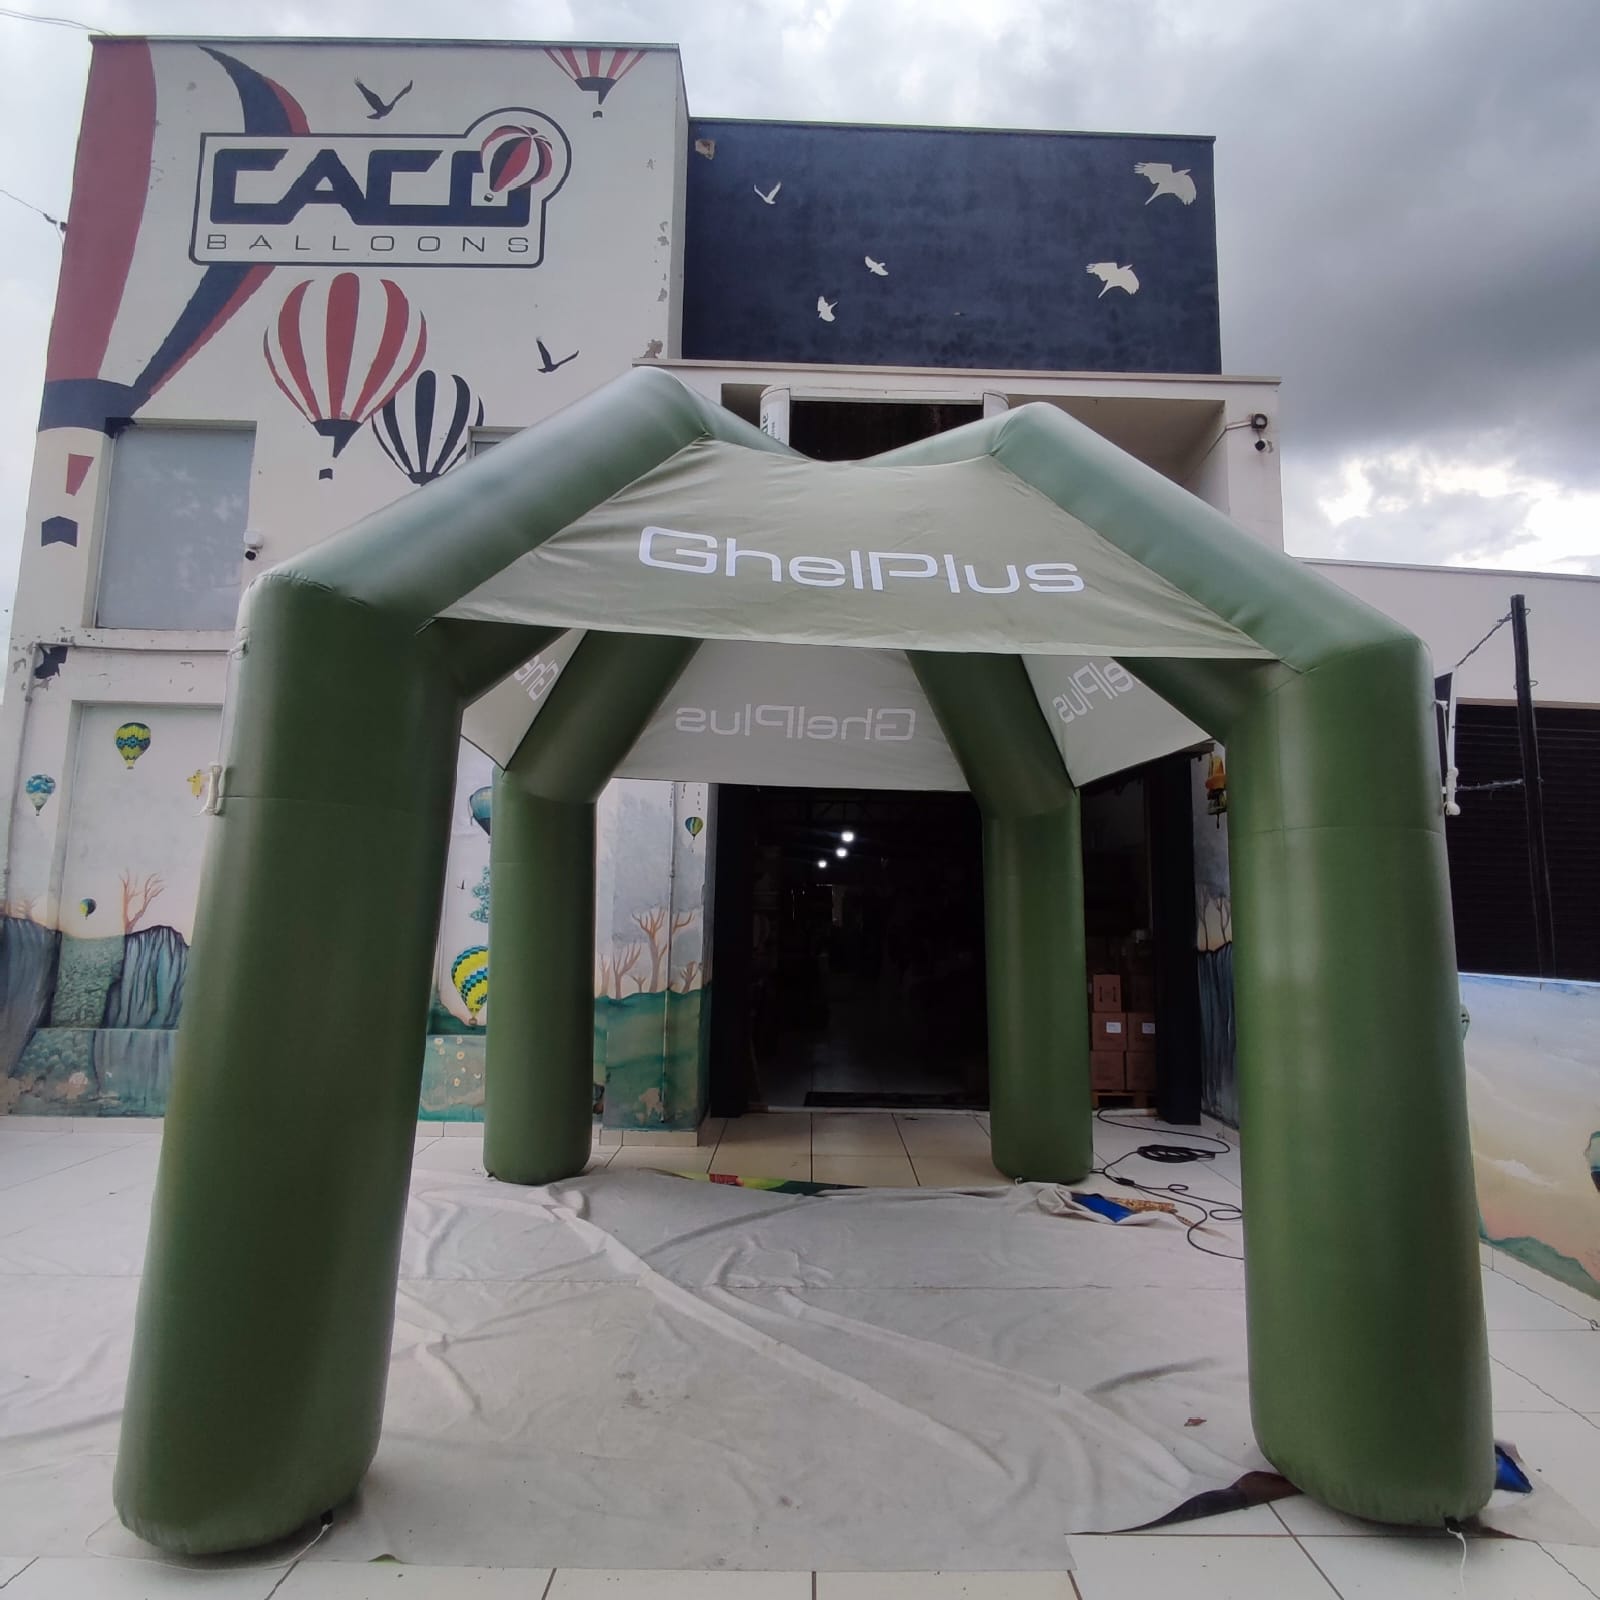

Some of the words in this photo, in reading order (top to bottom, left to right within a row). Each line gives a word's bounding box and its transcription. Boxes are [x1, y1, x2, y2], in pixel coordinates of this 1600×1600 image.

[209, 148, 531, 228] CACO
[205, 234, 530, 254] BALLOONS
[637, 525, 1086, 595] GhelPlus
